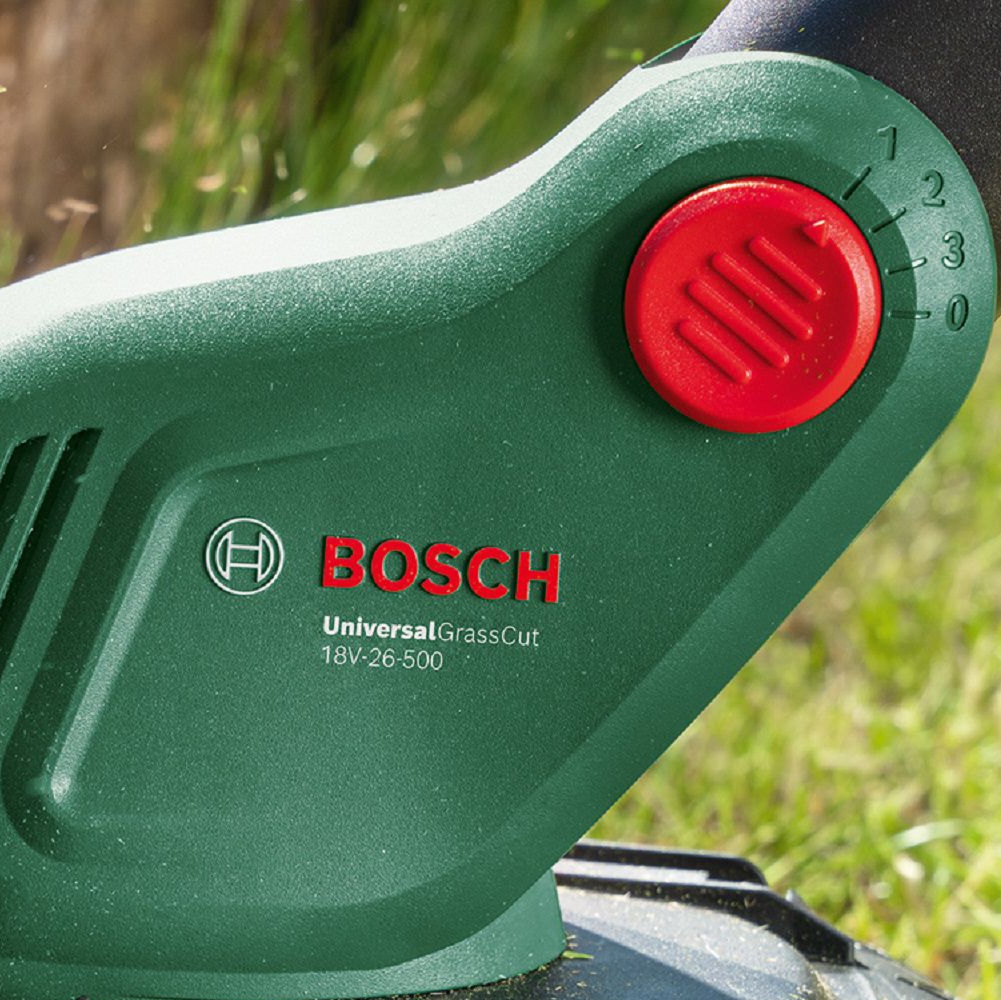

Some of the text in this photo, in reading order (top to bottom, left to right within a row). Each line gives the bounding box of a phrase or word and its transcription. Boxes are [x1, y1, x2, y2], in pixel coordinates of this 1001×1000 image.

[877, 124, 897, 161] 1
[921, 169, 946, 208] 2
[942, 231, 965, 270] 3
[946, 294, 969, 332] 0
[320, 535, 561, 603] BOSCH
[322, 615, 540, 647] UniversalGrassCut
[321, 645, 443, 671] 18V-26-500
